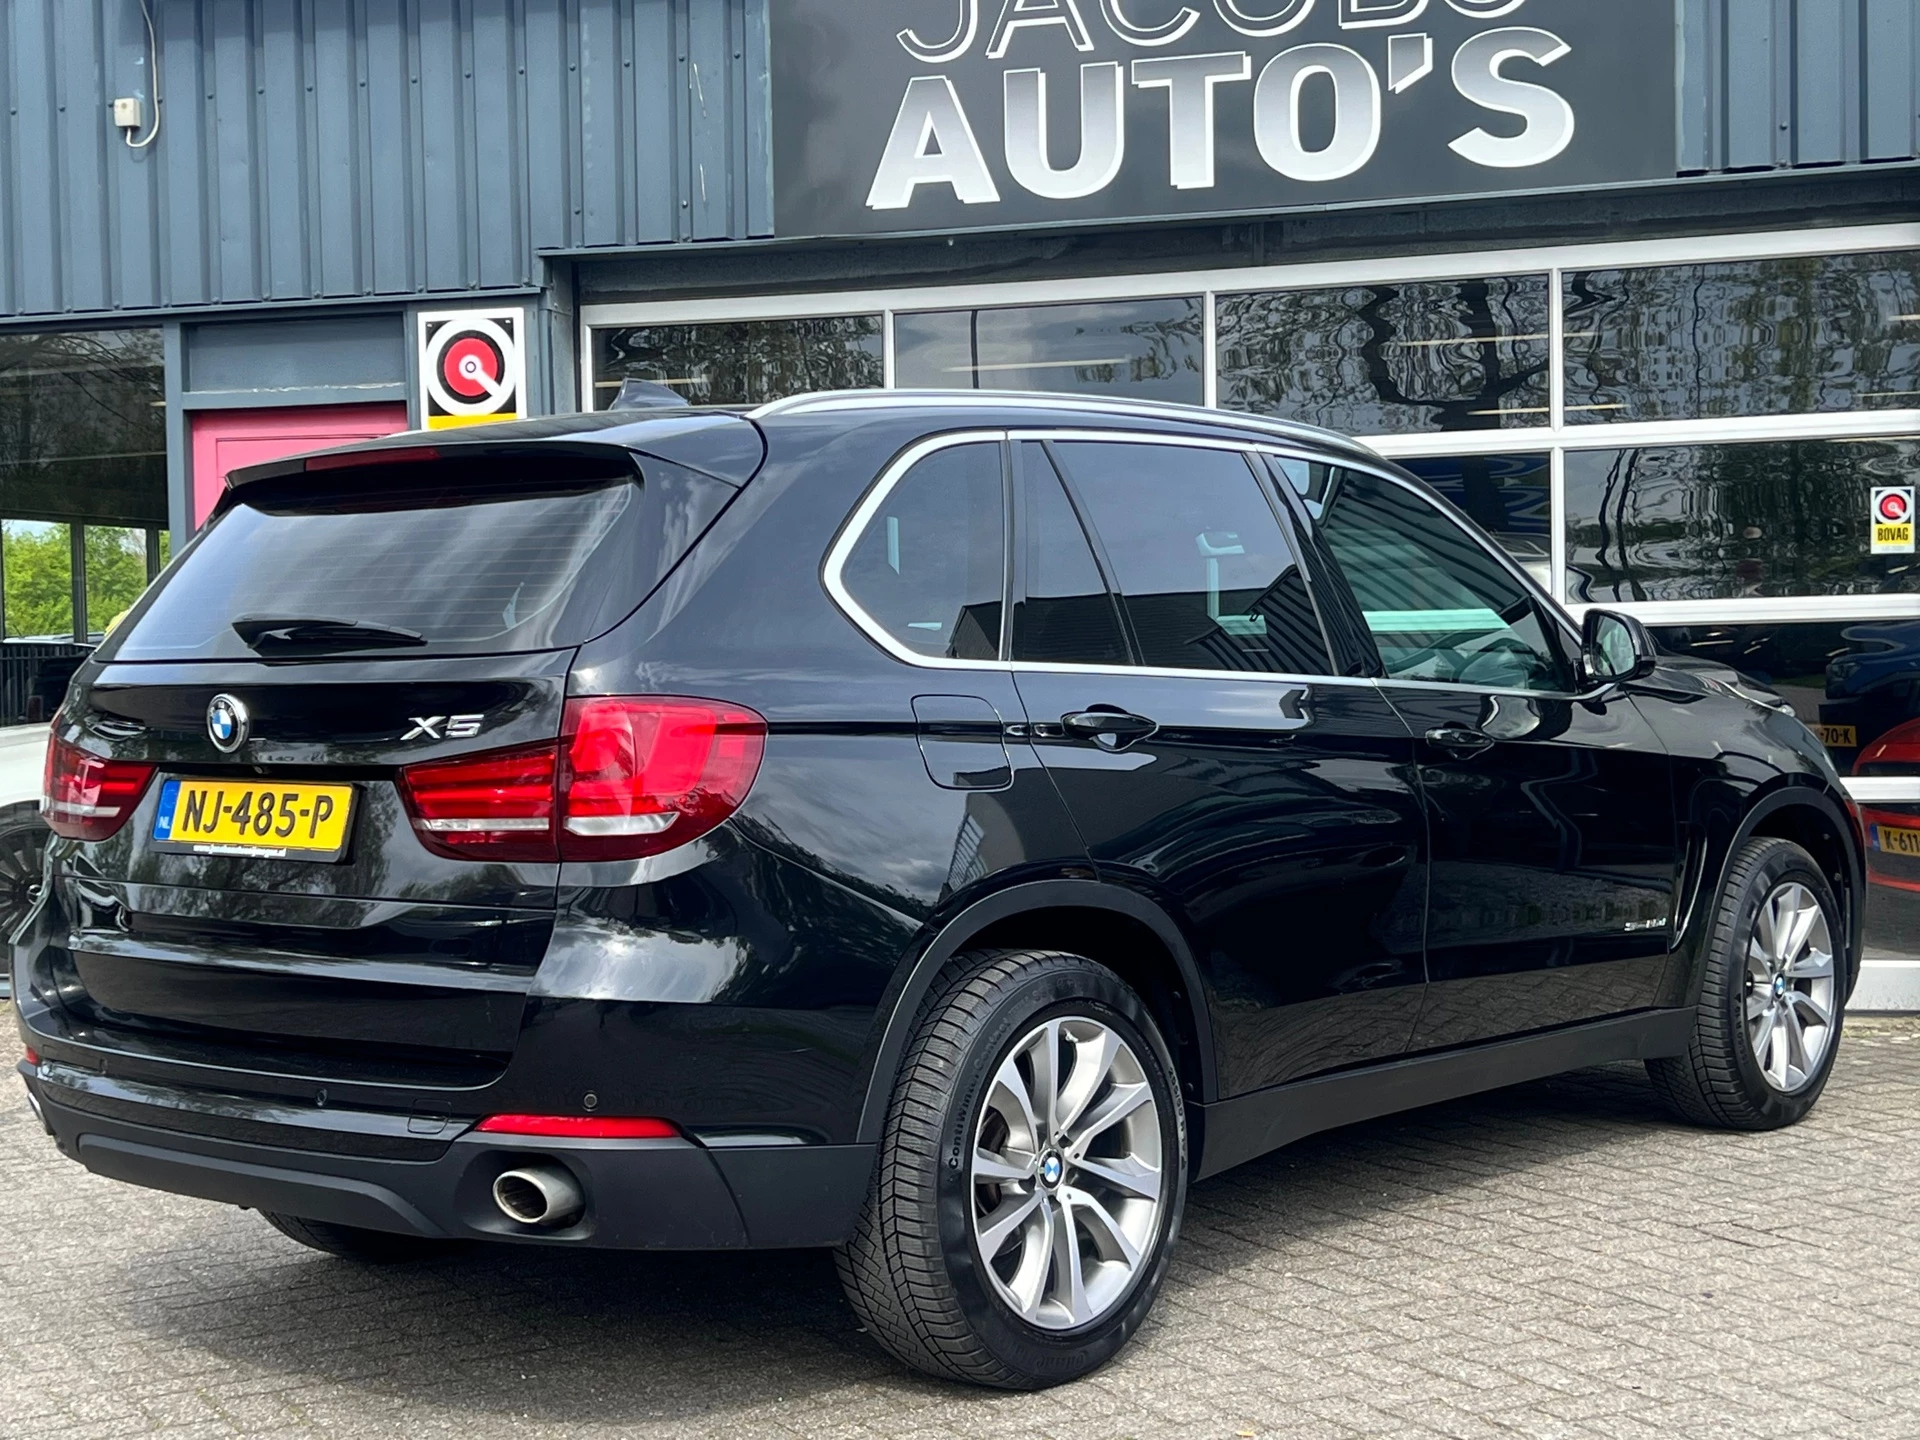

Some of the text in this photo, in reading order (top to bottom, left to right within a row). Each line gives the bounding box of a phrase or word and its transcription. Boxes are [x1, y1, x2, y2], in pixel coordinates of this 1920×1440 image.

[867, 26, 1575, 210] AUTO'S
[1877, 527, 1909, 541] BOVAG
[400, 714, 485, 741] X5
[158, 816, 170, 829] NL
[182, 790, 334, 839] NJ-485-P
